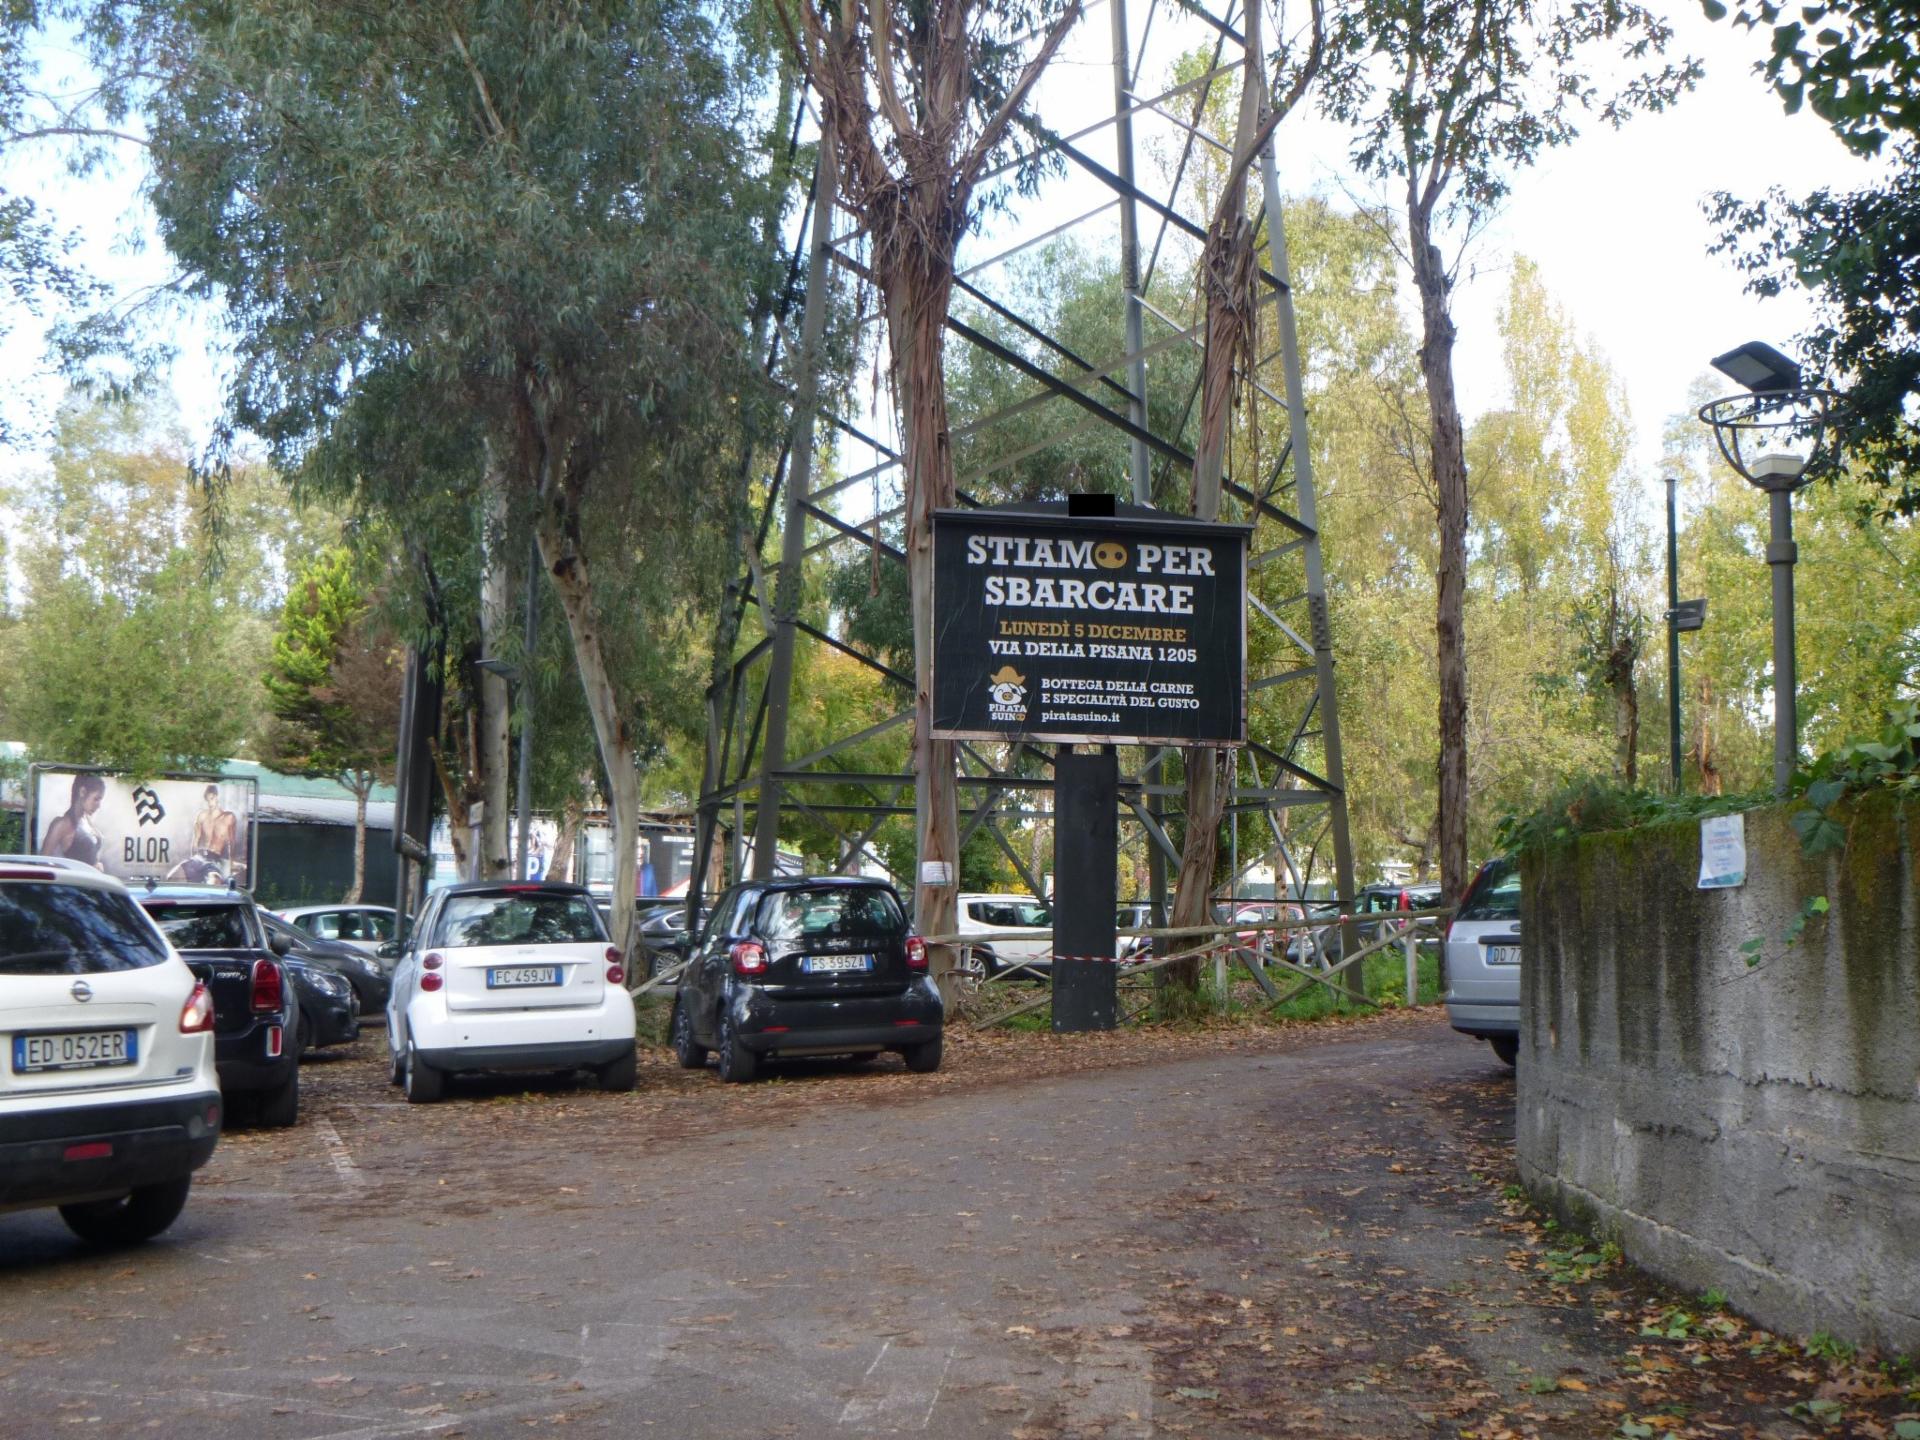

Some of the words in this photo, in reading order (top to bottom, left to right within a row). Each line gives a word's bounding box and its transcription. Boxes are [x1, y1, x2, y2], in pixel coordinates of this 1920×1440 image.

[967, 535, 1128, 570] STIAMO
[1136, 544, 1216, 577] PER
[985, 576, 1194, 615] SBARCARE
[1000, 619, 1071, 637] LUNEDÌ
[1074, 624, 1085, 638] 5
[1087, 624, 1186, 643] DICEMBRE
[988, 640, 1022, 655] VIA
[1024, 641, 1086, 657] DELLA
[1088, 643, 1154, 661] PISANA
[1158, 647, 1197, 663] 1205
[1041, 678, 1104, 692] BOTTEGA
[1106, 680, 1148, 693] DELLA
[1150, 682, 1194, 695] CARNE
[988, 703, 1028, 713] PIRATA
[1041, 693, 1050, 704] E
[1053, 693, 1127, 707] SPECIALITÀ
[1129, 696, 1156, 708] DEL
[1157, 697, 1200, 710] GUSTO
[1041, 709, 1121, 723] piratasuino.it
[124, 836, 170, 864] BLOR
